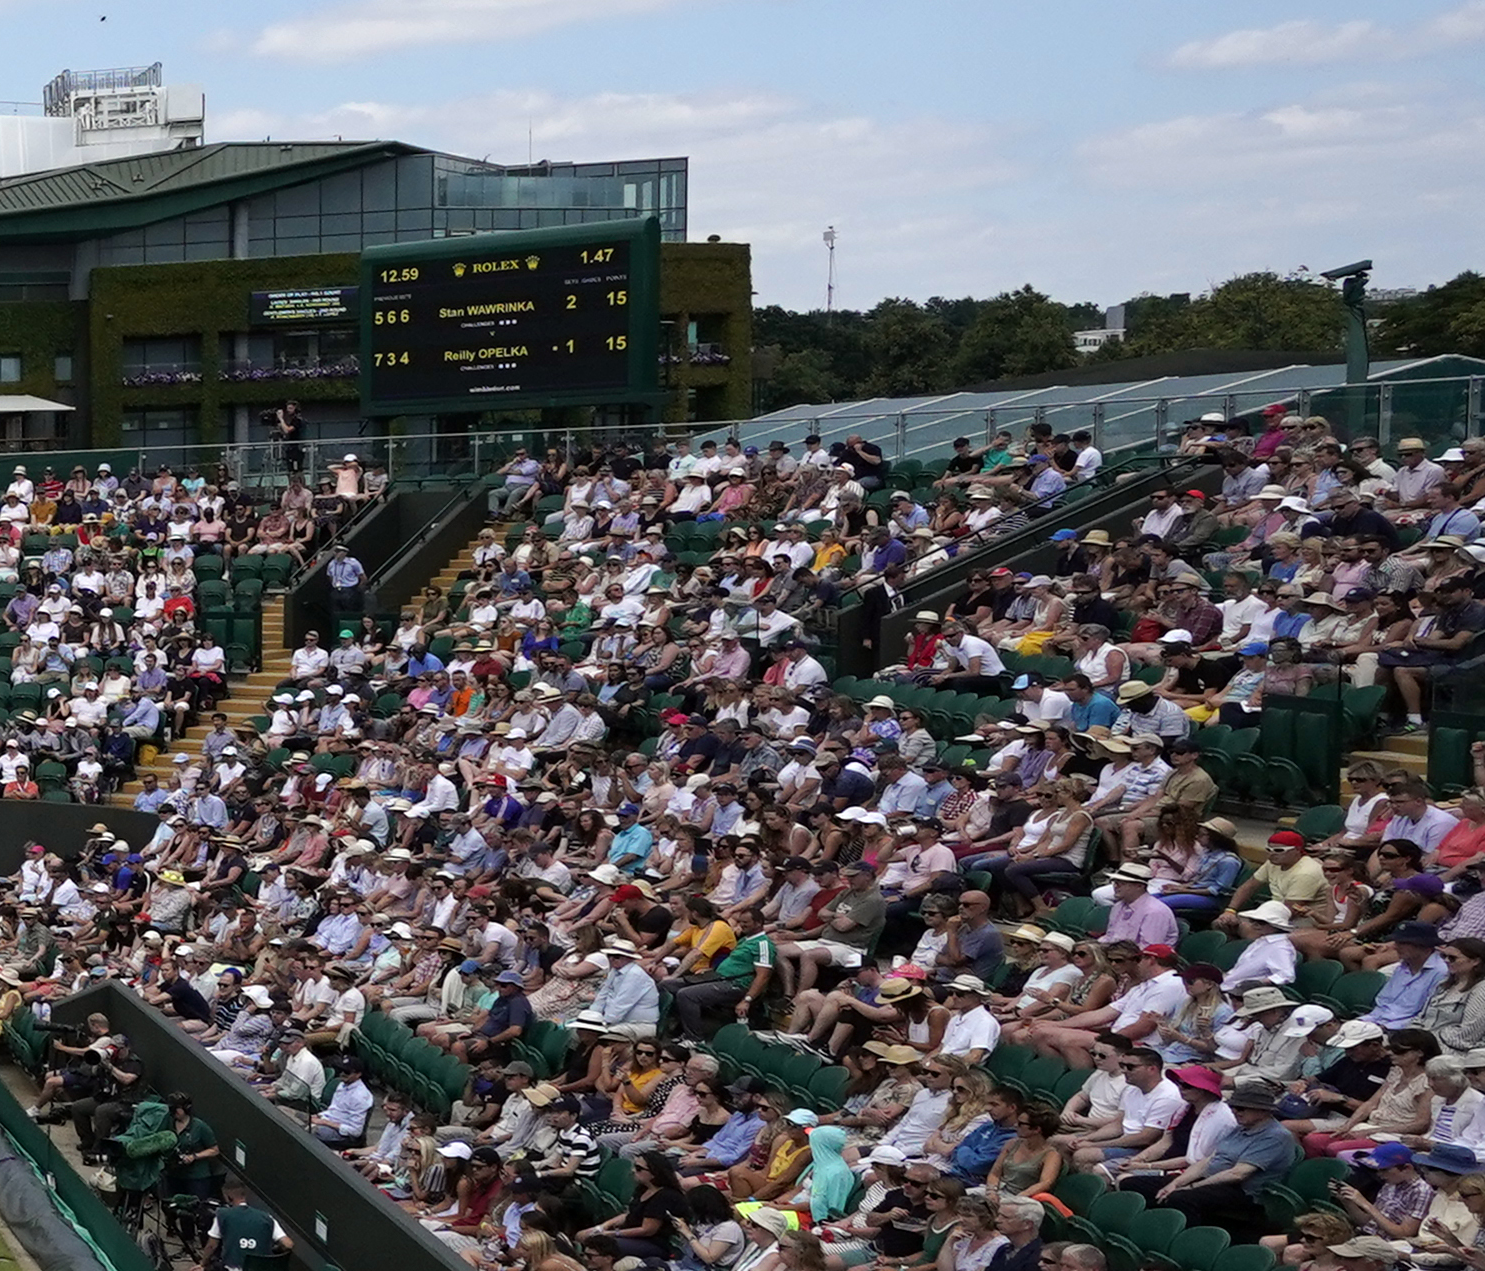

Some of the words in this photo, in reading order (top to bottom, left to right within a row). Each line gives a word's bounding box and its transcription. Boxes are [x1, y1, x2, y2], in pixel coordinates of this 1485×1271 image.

[580, 248, 614, 264] 1.47
[472, 260, 520, 274] ROLEX
[380, 268, 419, 283] 12.59
[566, 294, 577, 309] 2
[607, 290, 627, 306] 15
[374, 311, 384, 325] 5
[387, 310, 396, 324] 6
[400, 309, 409, 323] 6
[439, 308, 464, 318] Stan
[467, 301, 535, 316] WAWRINKA
[566, 339, 574, 353] 1
[606, 336, 627, 351] 15
[374, 353, 383, 367] 7
[387, 352, 396, 366] 3
[399, 351, 409, 365] 4
[444, 350, 476, 362] Reilly
[478, 346, 528, 359] OPELKA
[239, 1238, 257, 1249] 99
